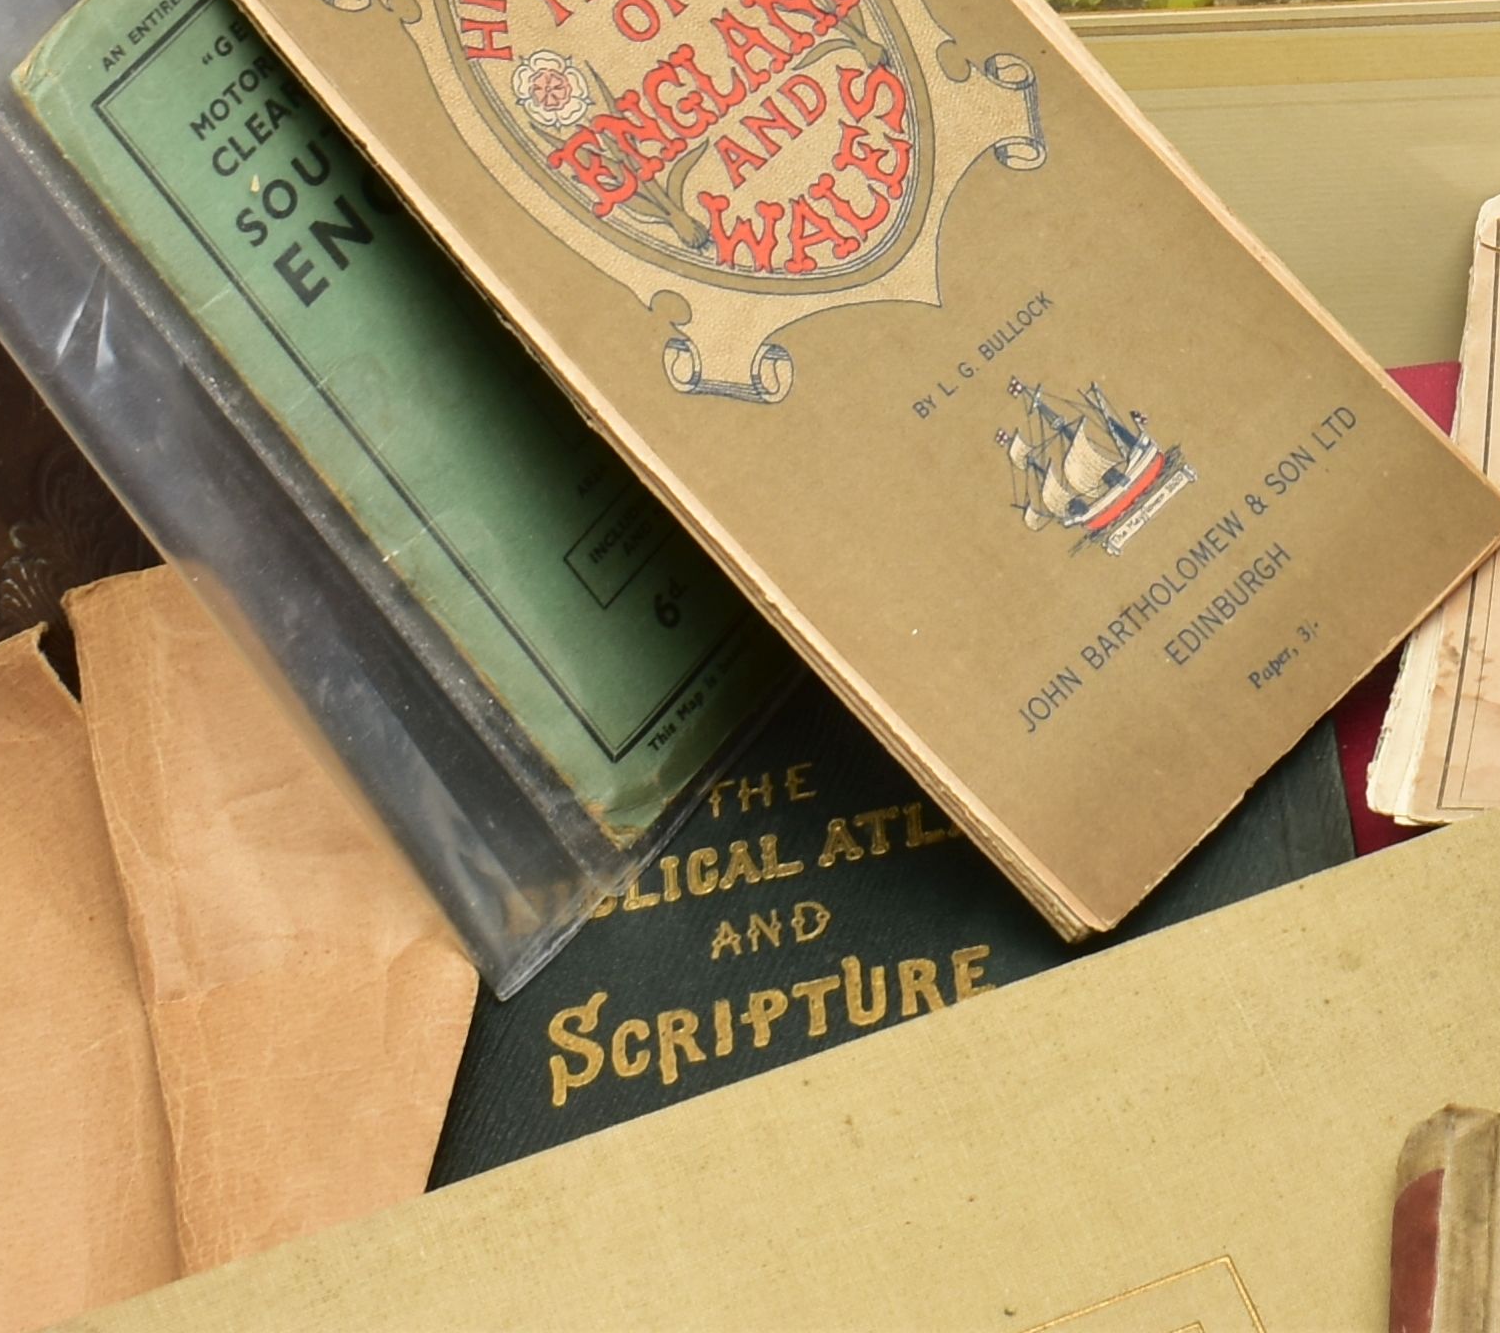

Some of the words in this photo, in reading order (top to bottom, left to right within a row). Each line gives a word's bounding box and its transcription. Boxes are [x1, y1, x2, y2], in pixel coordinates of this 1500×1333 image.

[101, 46, 127, 72] AN
[697, 65, 913, 274] WALES
[714, 74, 827, 188] AND
[912, 398, 938, 420] BY
[938, 377, 959, 396] L.
[958, 360, 980, 379] G.
[978, 291, 1055, 362] BULLOCK
[1018, 666, 1084, 733] JOHN
[1080, 508, 1246, 671] BARTHOLOMEW
[1245, 493, 1269, 515] &
[1264, 444, 1316, 497] SON
[1313, 405, 1358, 451] LTD
[1164, 542, 1291, 667] EDINBURGH
[1248, 644, 1299, 690] Paper,
[648, 723, 678, 751] This
[676, 692, 706, 721] Map
[710, 763, 819, 817] THE
[819, 801, 969, 866] ATL
[710, 902, 831, 959] AND
[548, 945, 997, 1106] SCRIPTURE
